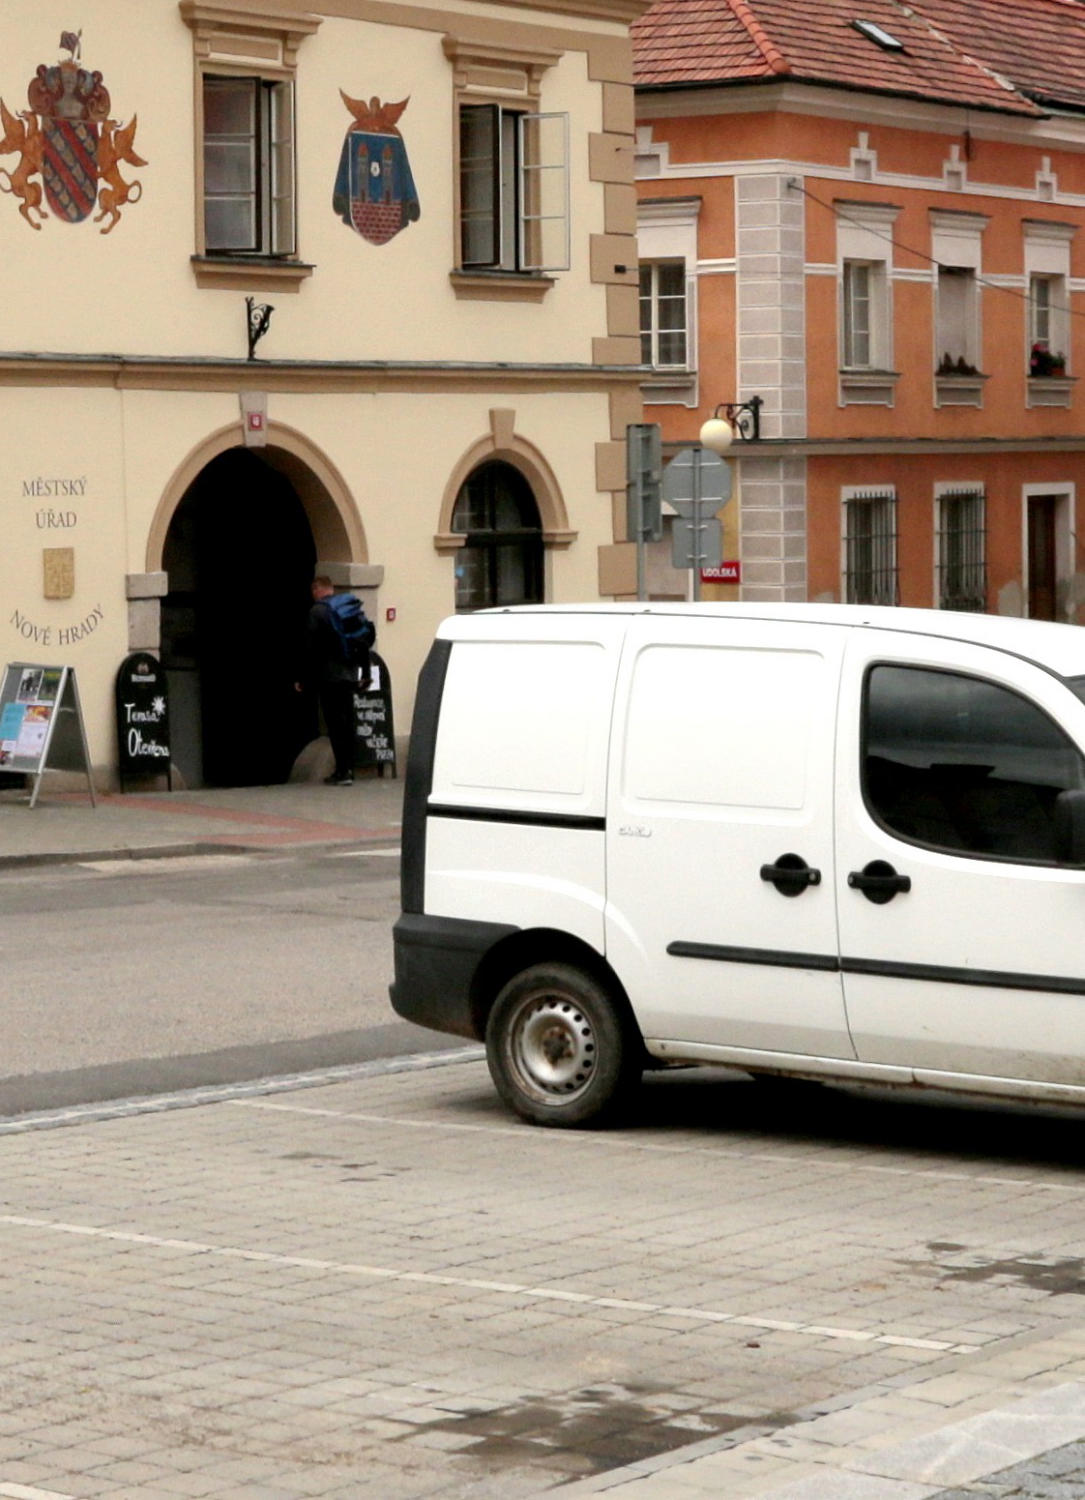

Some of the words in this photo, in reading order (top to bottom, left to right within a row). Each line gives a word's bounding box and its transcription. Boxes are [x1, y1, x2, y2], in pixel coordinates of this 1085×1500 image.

[22, 476, 88, 497] MĚSTSKÝ
[36, 508, 77, 529] ÚŘAD
[10, 609, 51, 646] NOVÉ
[59, 603, 105, 646] HRADY
[124, 703, 161, 723] Terasa
